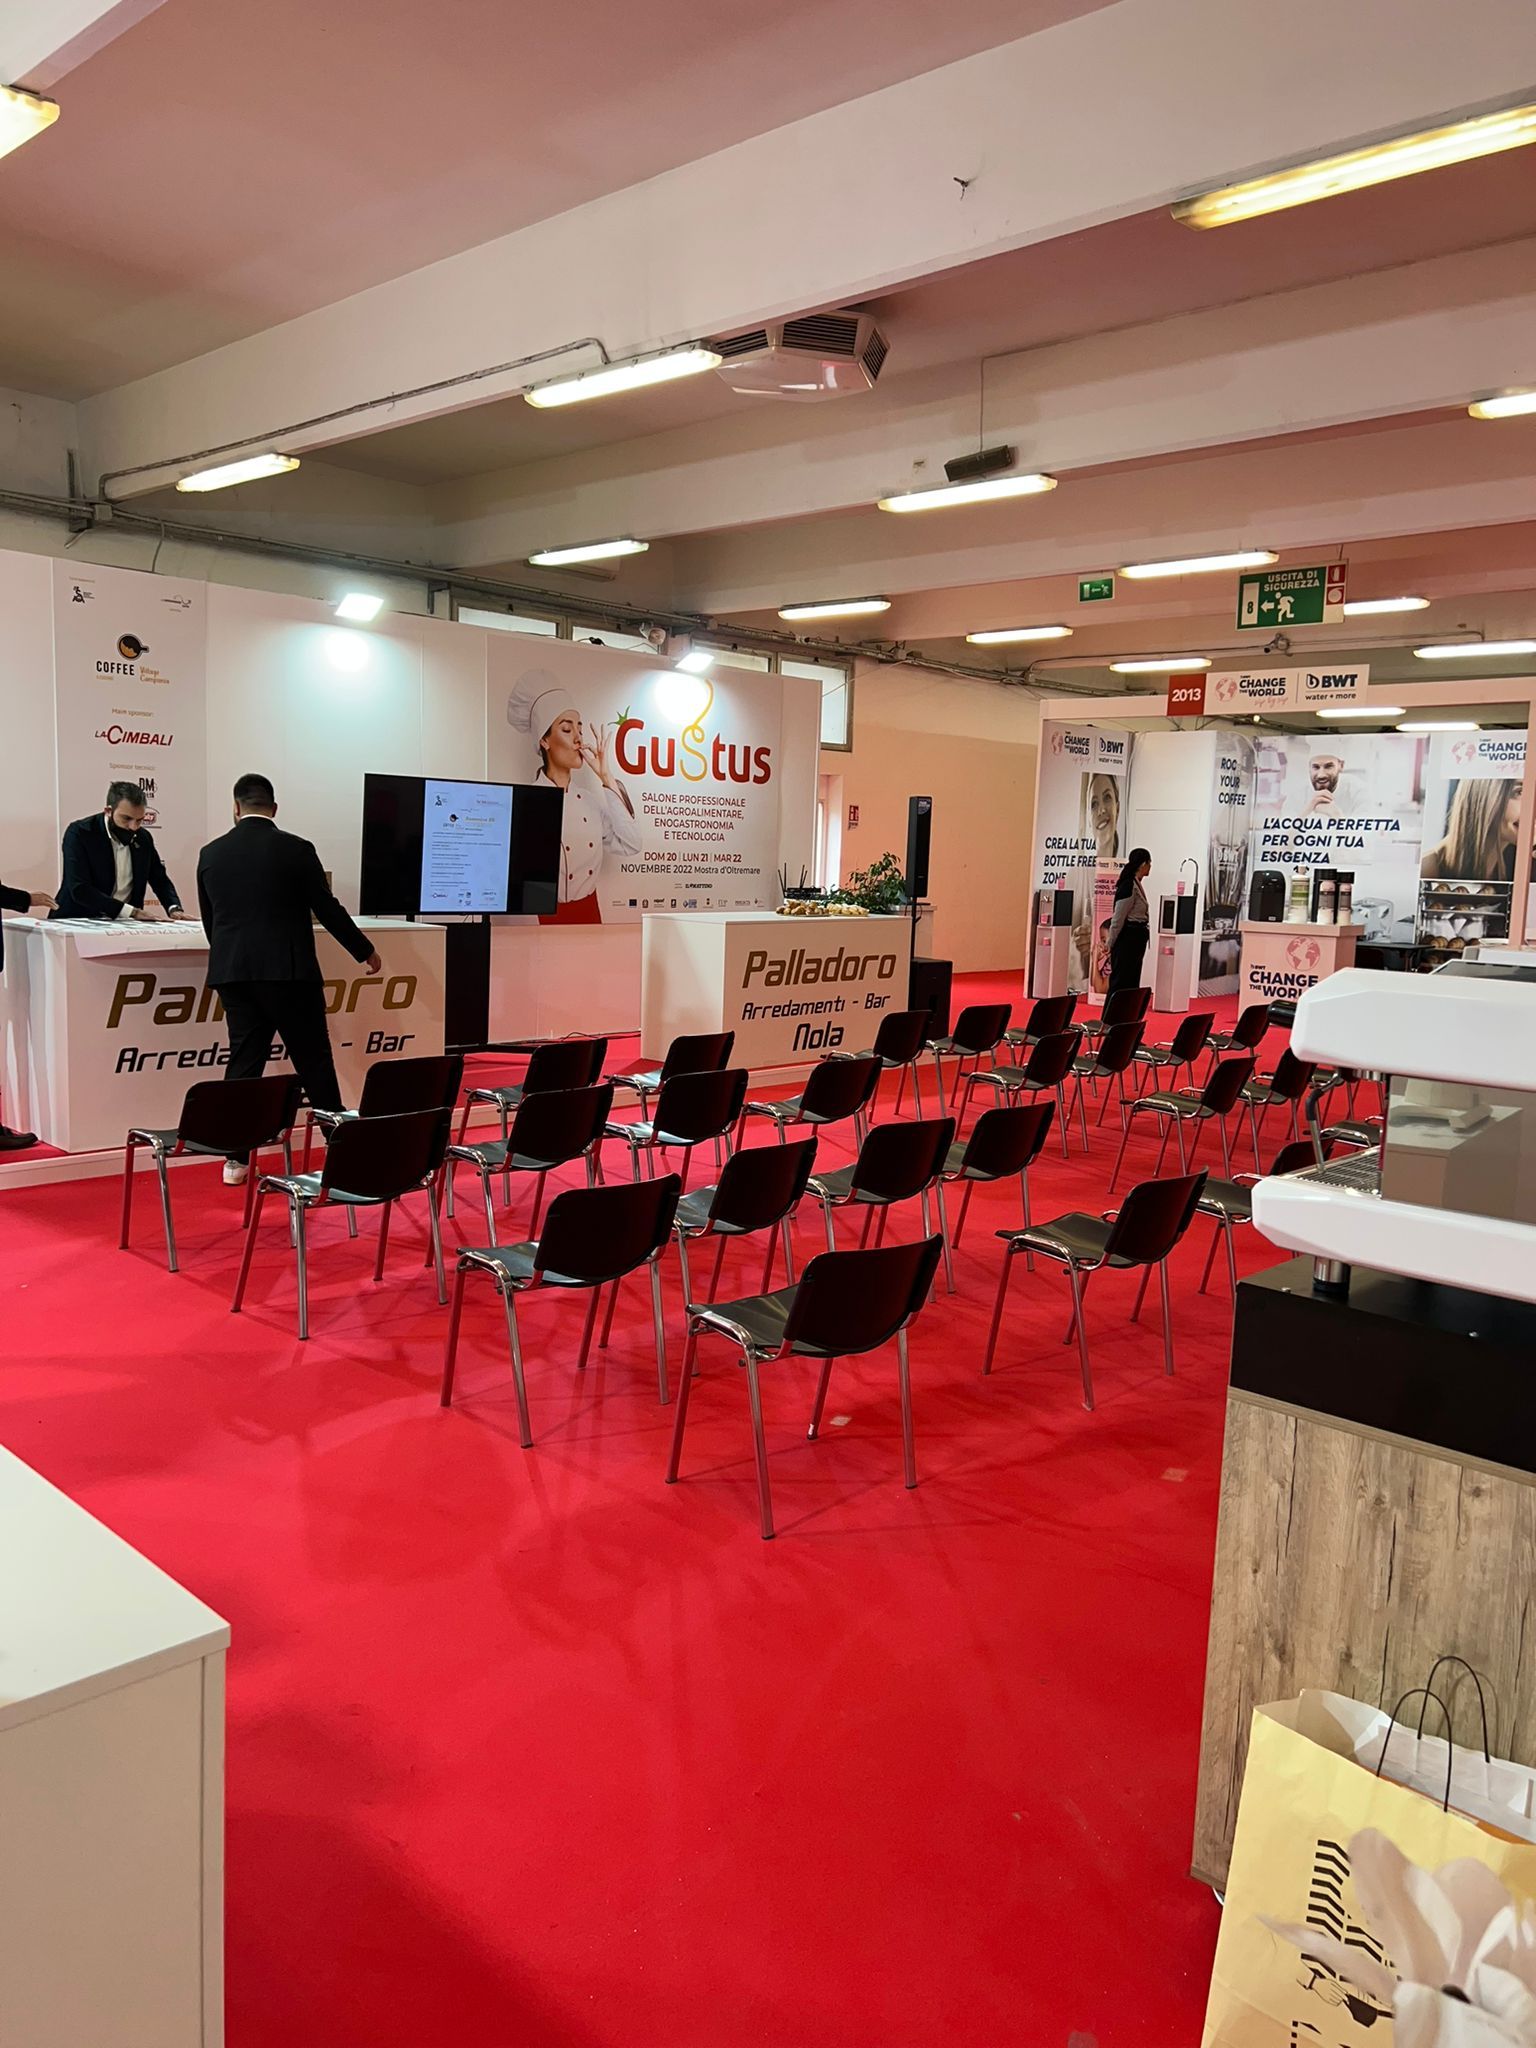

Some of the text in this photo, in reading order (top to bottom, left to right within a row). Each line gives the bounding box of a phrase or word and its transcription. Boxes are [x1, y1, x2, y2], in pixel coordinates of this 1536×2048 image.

[1267, 570, 1318, 583] USCITA DI
[1264, 578, 1320, 592] SICUREZZA
[1246, 600, 1254, 614] 8
[96, 660, 135, 676] COFFEE
[1239, 677, 1286, 689] CHANGE
[1321, 674, 1358, 688] BWT
[1171, 688, 1202, 702] 2013
[1248, 687, 1286, 697] WORLD
[1335, 692, 1357, 700] more
[1064, 735, 1090, 747] CHANGE
[1106, 740, 1124, 754] BWT
[1069, 746, 1090, 755] WORLD
[1220, 775, 1241, 789] YOUR
[642, 792, 746, 807] SALONE PROFESSIONALE
[1218, 792, 1247, 806] COFFEE
[654, 818, 735, 830] ENOGASTRONOMIA
[1263, 818, 1401, 833] L'ACQUA PERFETTA
[664, 831, 726, 841] E TECNOLOGIA
[1045, 836, 1097, 850] CREA LA TUA
[1262, 835, 1365, 848] PER OGNI TUA
[644, 852, 742, 863] DOM 20 LUN 21 MAR 22
[1043, 855, 1076, 867] BOTTLE
[1077, 855, 1097, 867] FREE
[1261, 851, 1330, 864] ESIGENZA
[621, 863, 761, 875] NOVEMBRE 2022 Mostra d'Oltremare
[742, 946, 897, 988] Palladoro
[1249, 970, 1319, 988] CHANGE
[741, 996, 846, 1020] Arredamenti
[864, 993, 891, 1009] Bar
[365, 1031, 416, 1054] Bar
